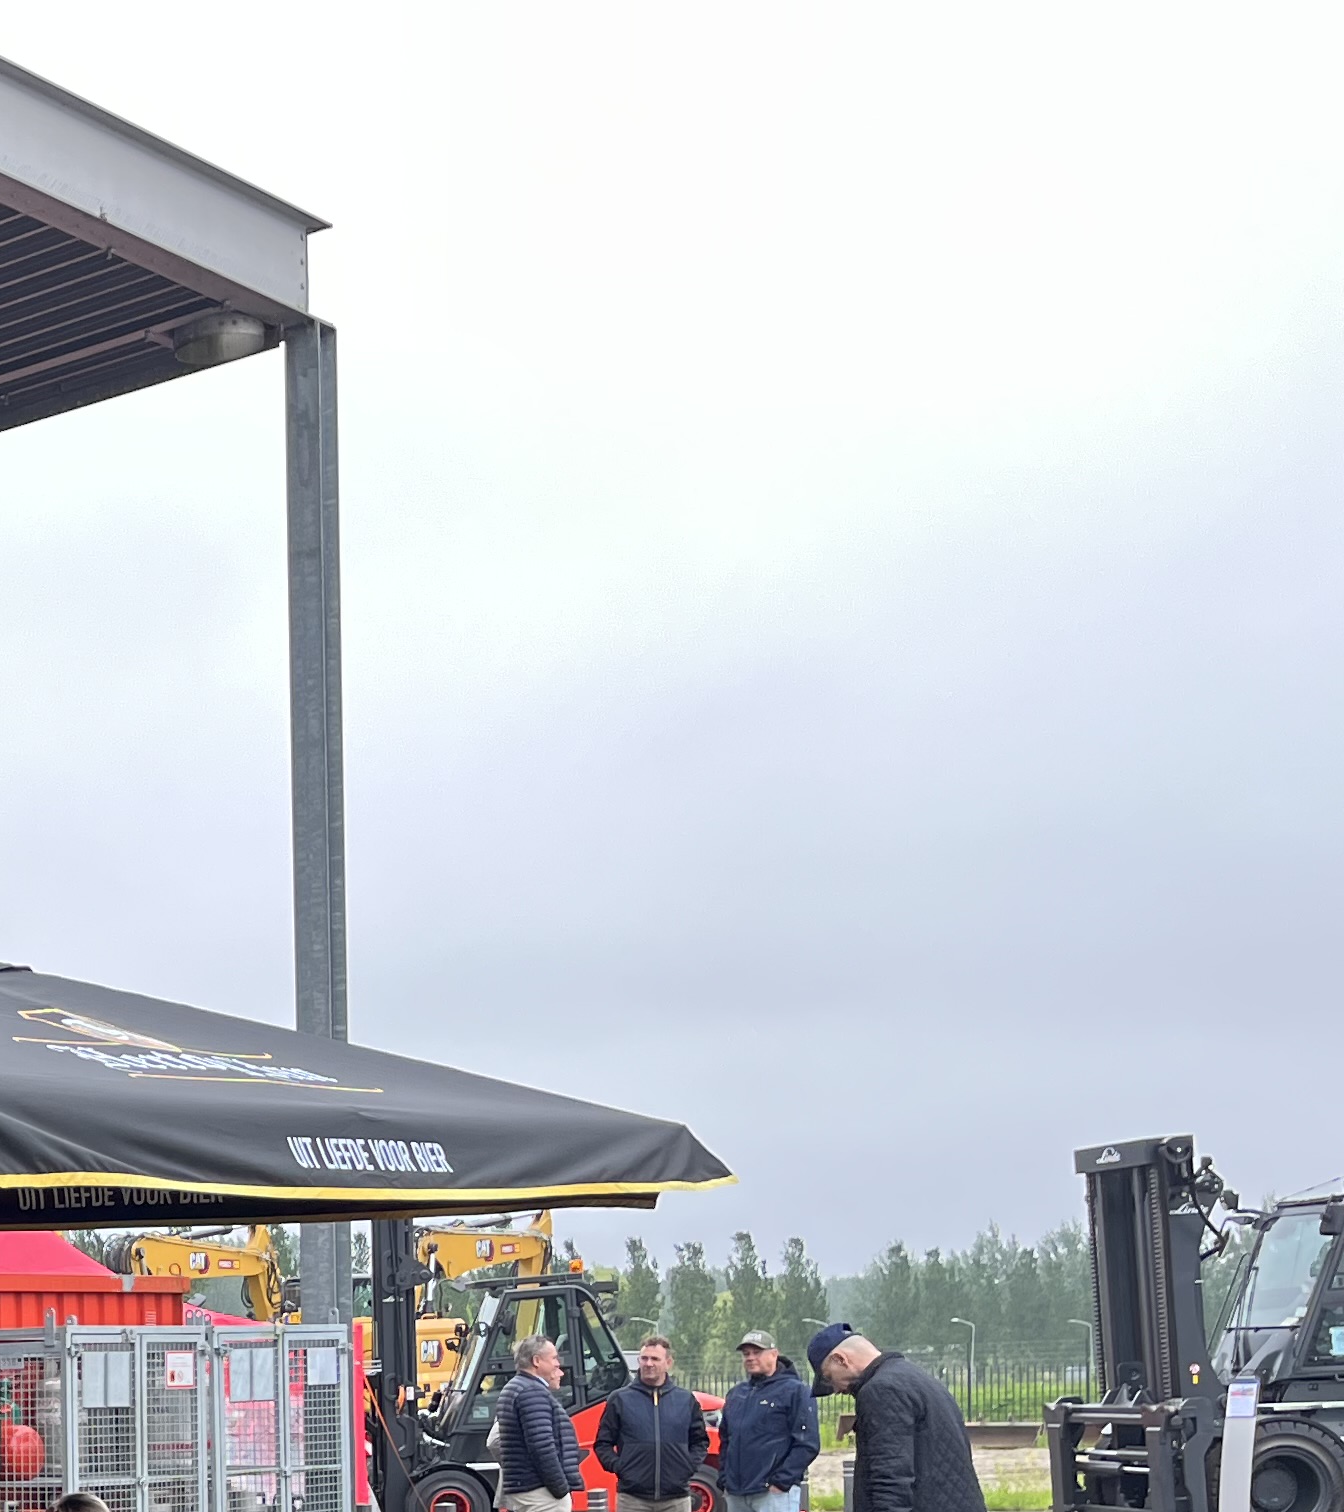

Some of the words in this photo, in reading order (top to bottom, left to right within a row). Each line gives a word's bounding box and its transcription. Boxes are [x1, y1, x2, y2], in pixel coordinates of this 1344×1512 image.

[286, 1136, 321, 1169] UIT
[316, 1137, 375, 1171] LIEFDE
[368, 1138, 417, 1172] VOOR
[410, 1141, 454, 1173] BIER
[476, 1239, 491, 1258] CAT
[190, 1252, 206, 1270] CAT
[421, 1340, 439, 1362] CAT
